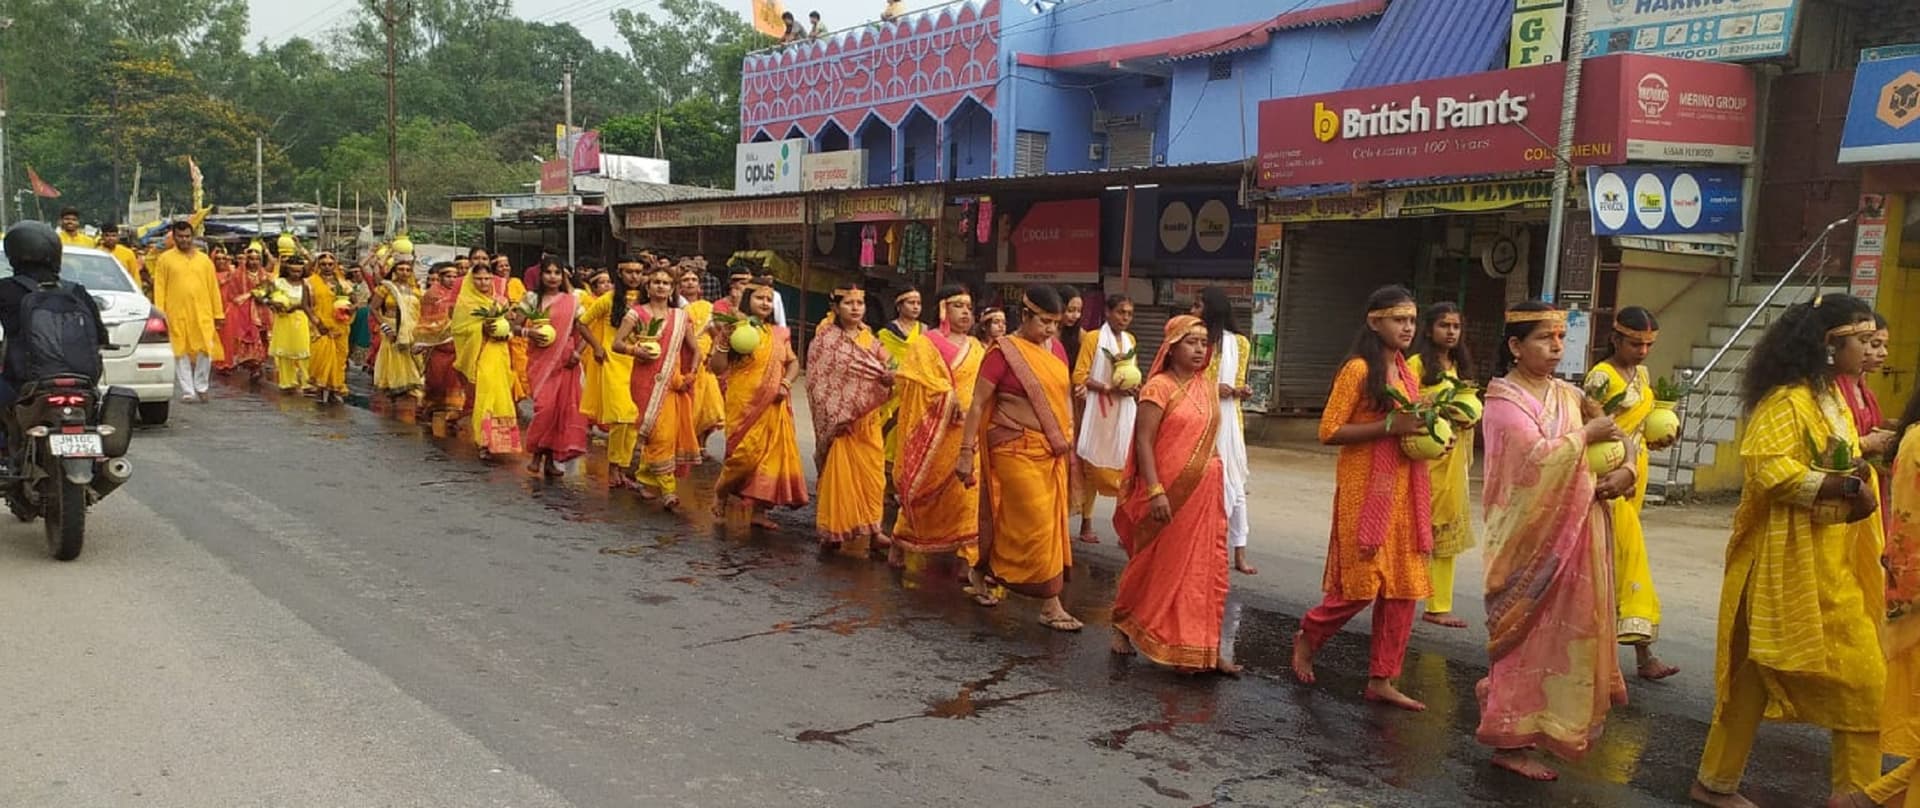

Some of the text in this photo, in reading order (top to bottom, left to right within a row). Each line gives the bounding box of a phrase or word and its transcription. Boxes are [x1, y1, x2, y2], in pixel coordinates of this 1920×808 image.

[1679, 92, 1747, 110] MERINO GROUP
[1343, 89, 1528, 139] British Paints
[745, 162, 775, 186] opus
[1403, 184, 1467, 207] ASSAM
